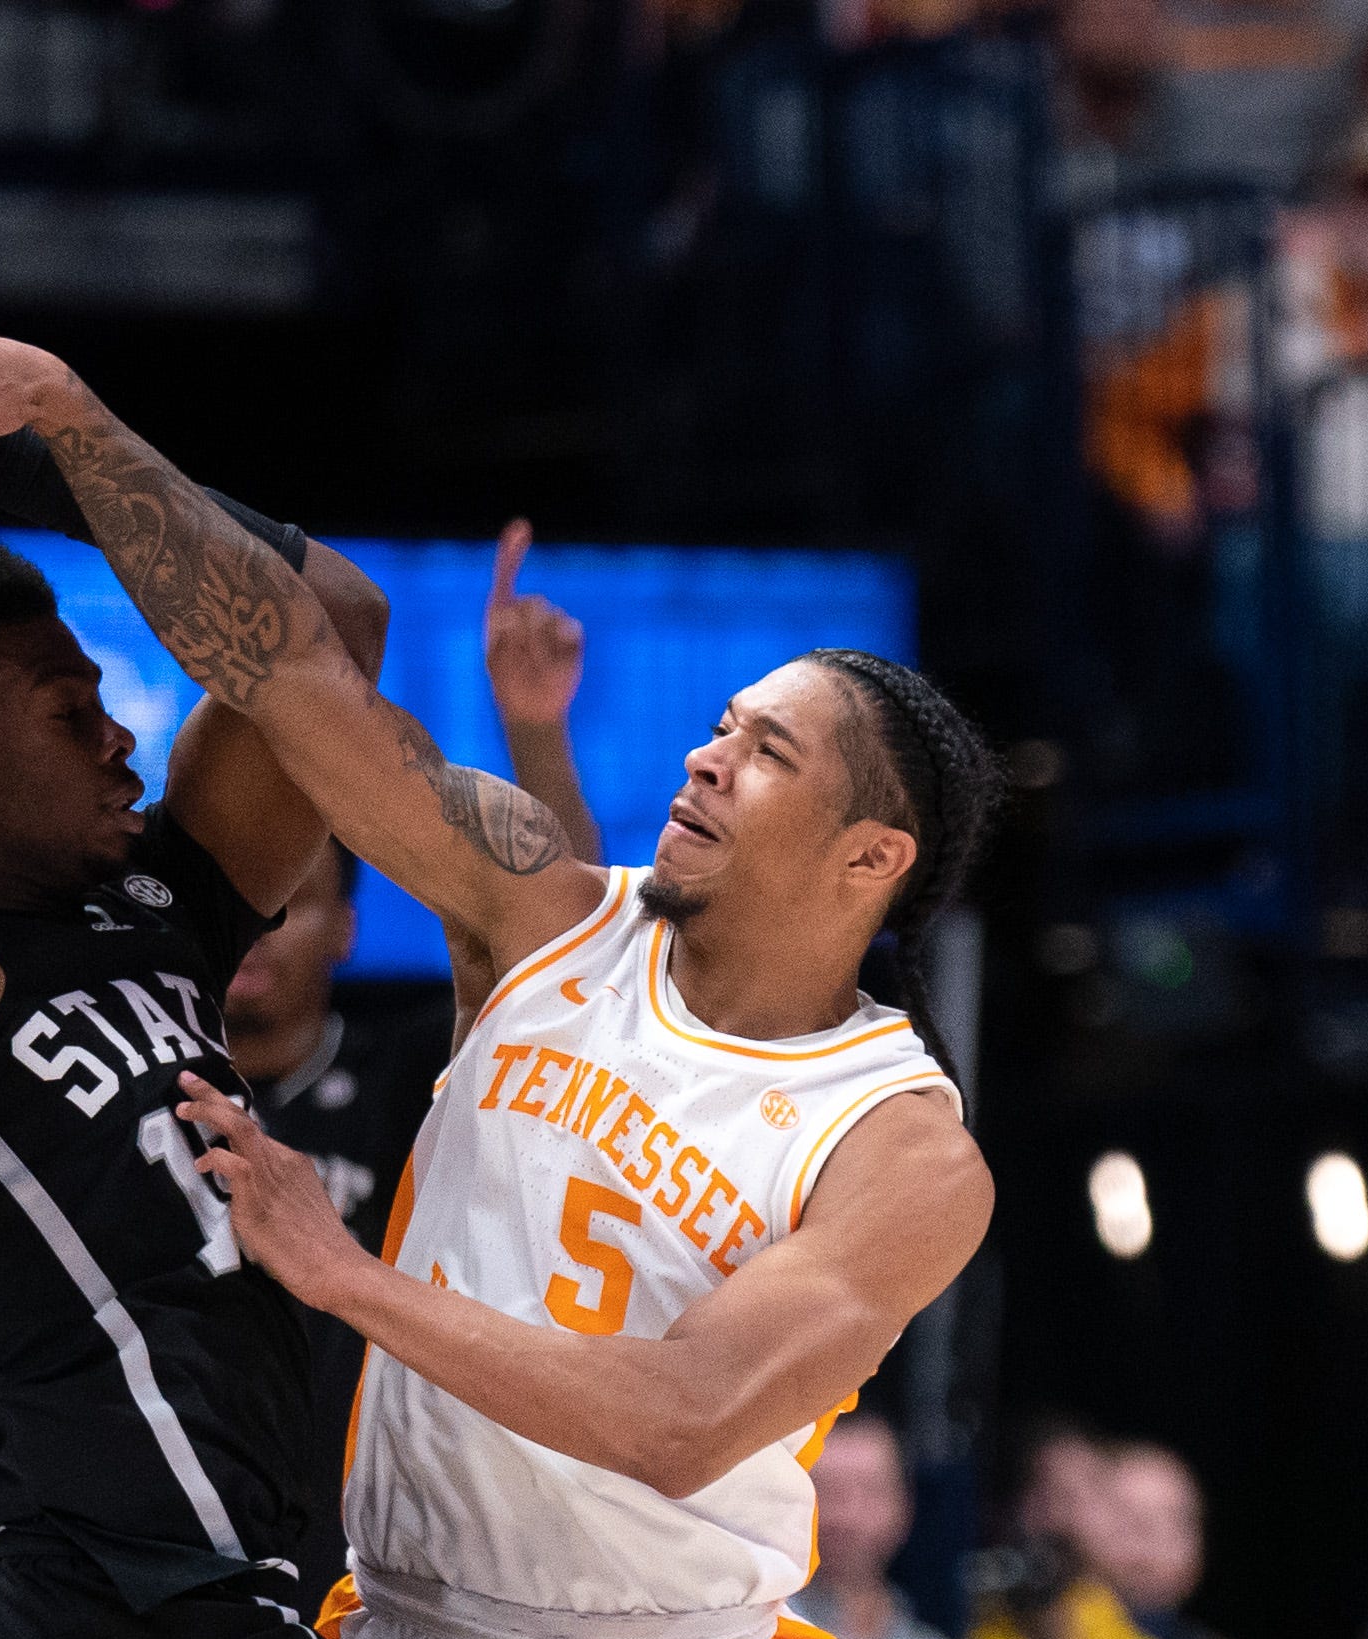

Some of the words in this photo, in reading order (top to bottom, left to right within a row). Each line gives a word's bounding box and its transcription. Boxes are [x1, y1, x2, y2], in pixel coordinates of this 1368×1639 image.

[11, 971, 235, 1118] STAT
[763, 1093, 798, 1128] SEC
[137, 1095, 244, 1278] 1
[479, 1044, 767, 1277] TENNESSEE
[543, 1176, 643, 1337] 5
